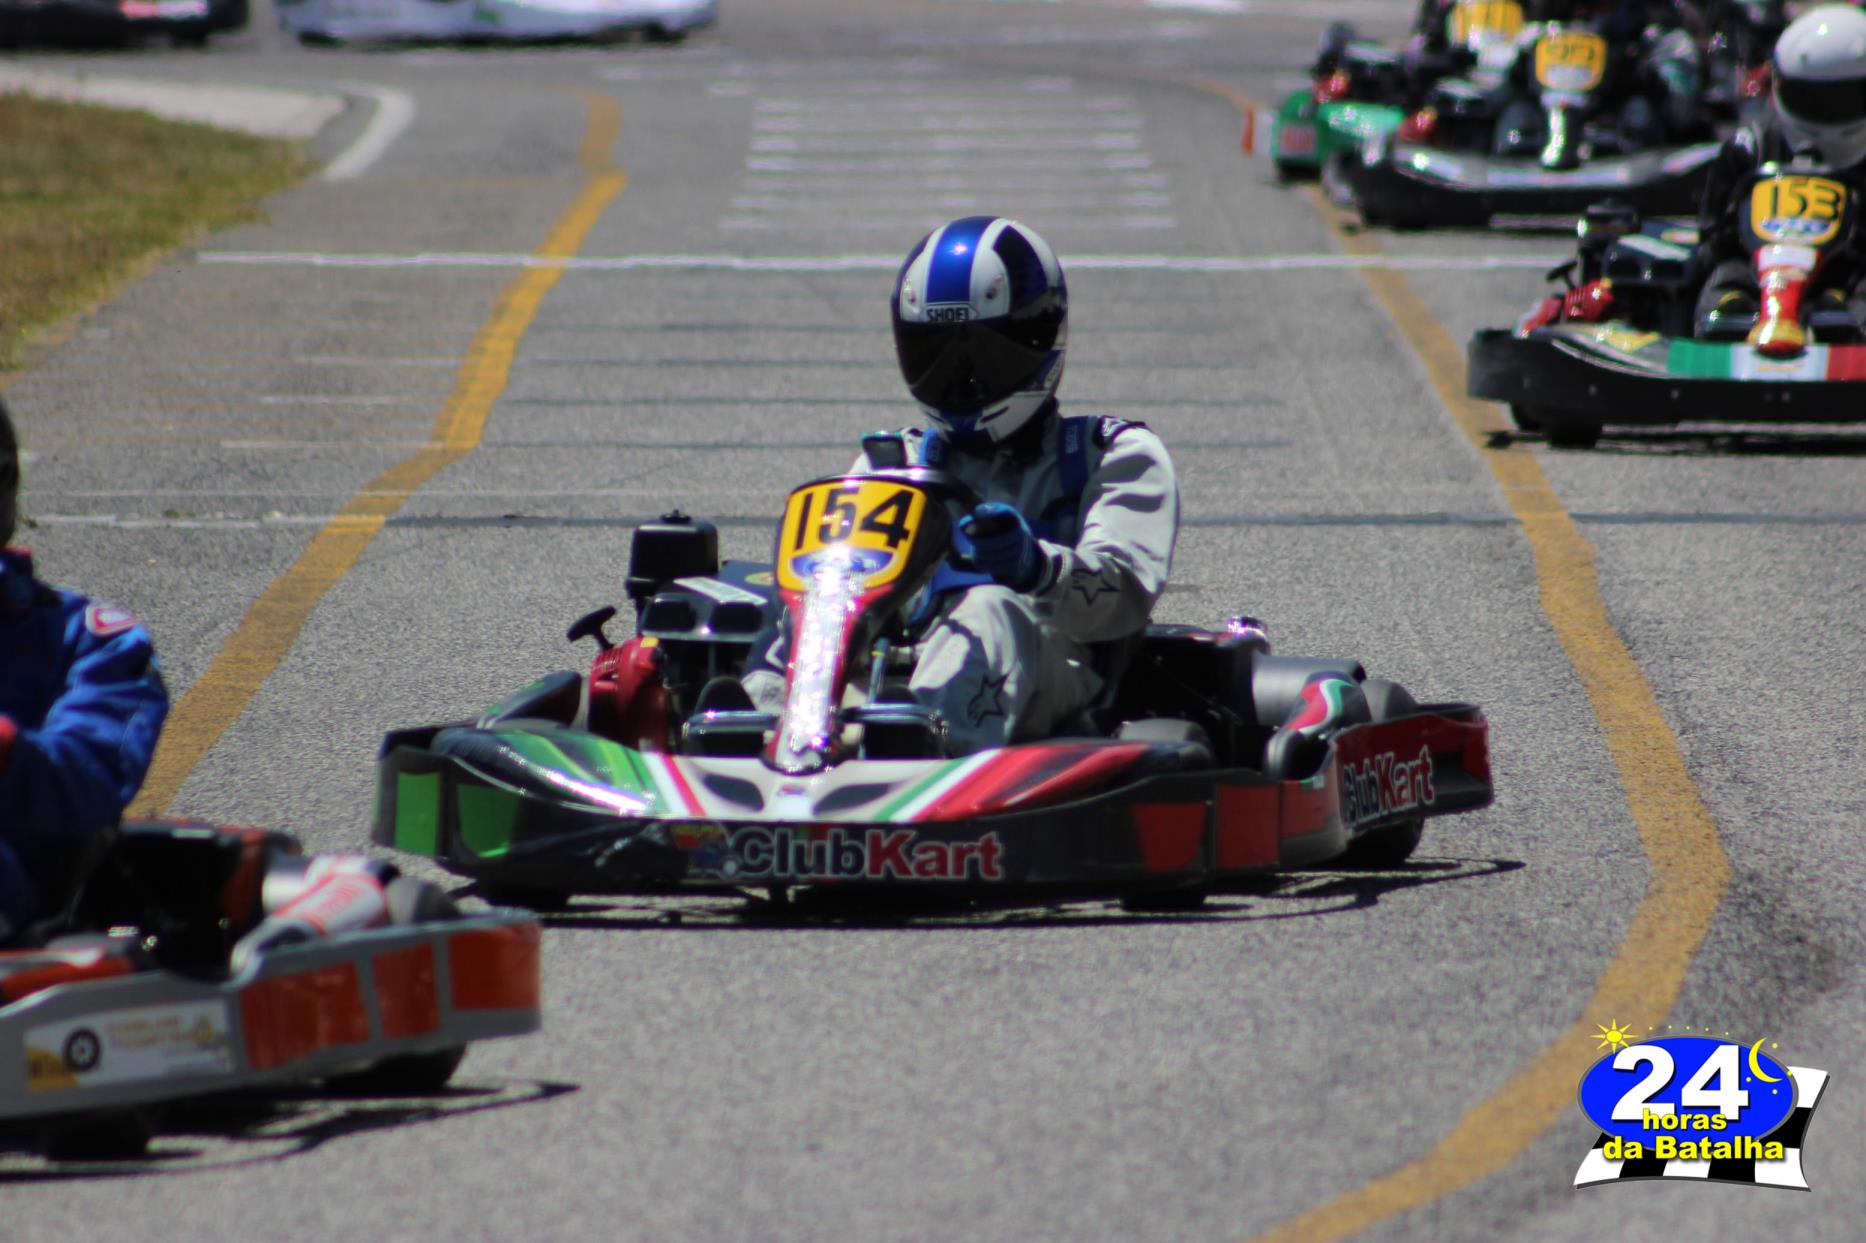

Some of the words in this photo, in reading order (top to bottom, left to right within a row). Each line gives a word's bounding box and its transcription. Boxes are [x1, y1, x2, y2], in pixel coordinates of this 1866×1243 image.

[927, 306, 969, 321] SHOEI
[794, 487, 914, 551] 154
[732, 827, 1004, 881] ClubKart
